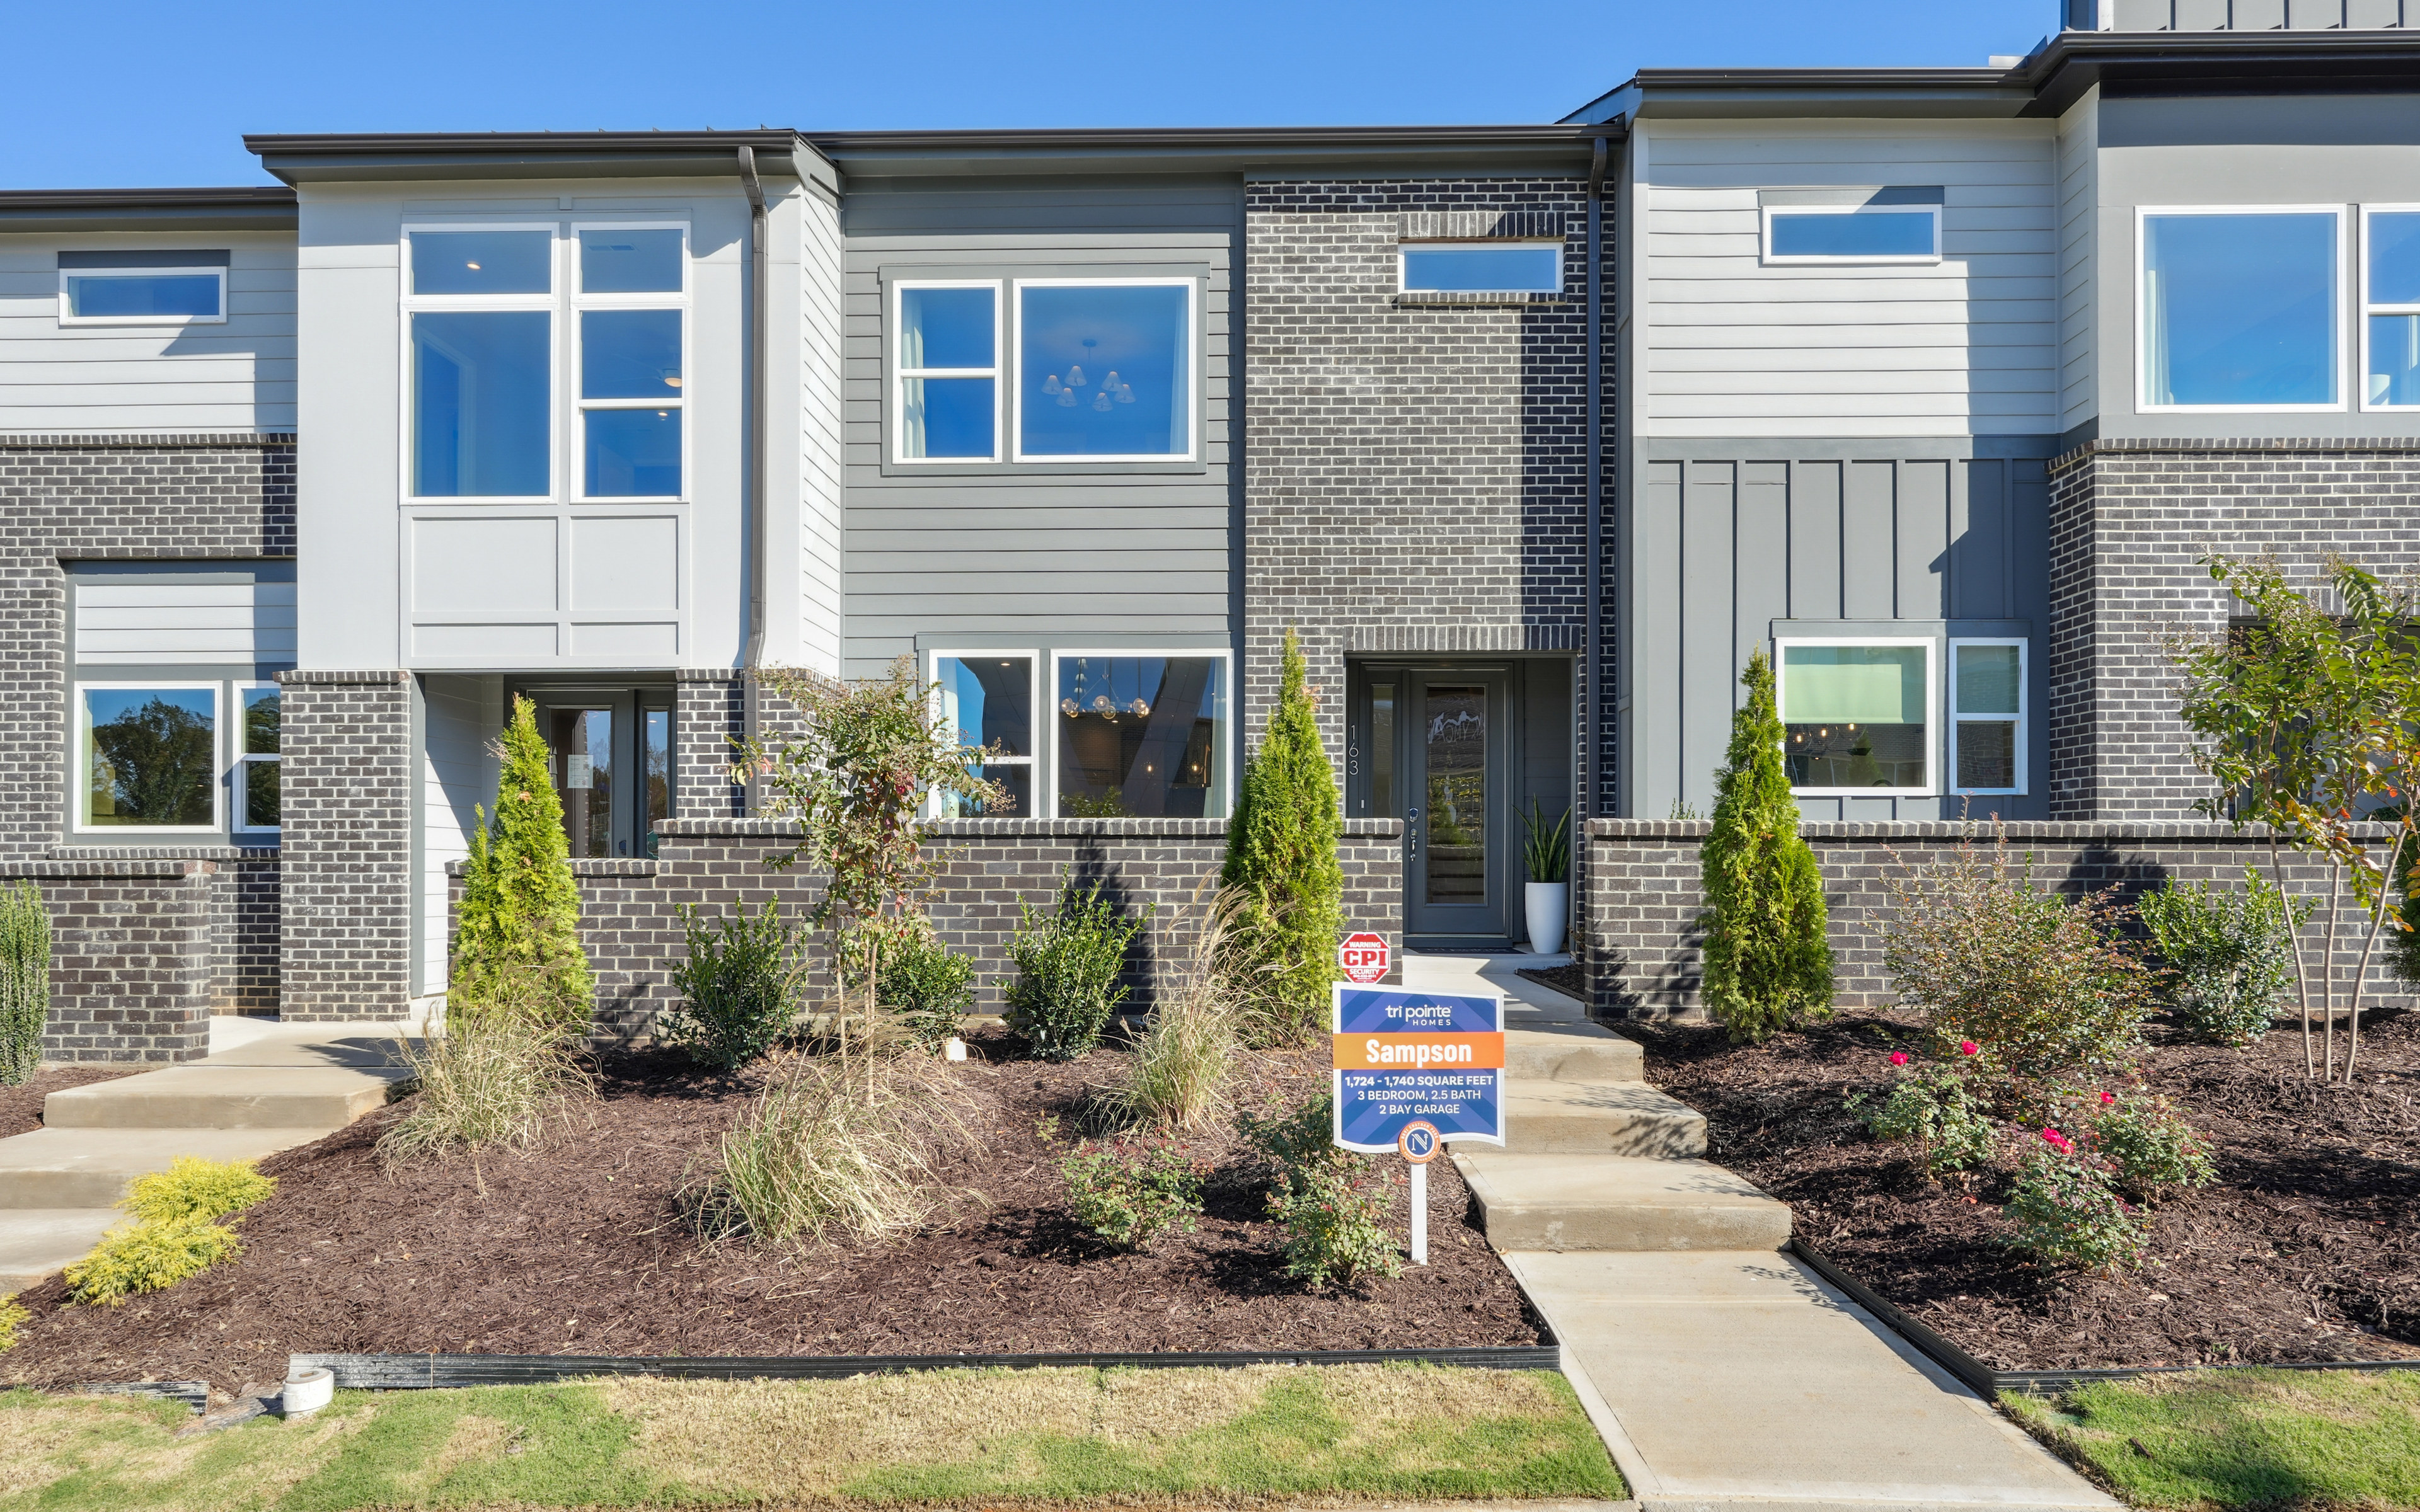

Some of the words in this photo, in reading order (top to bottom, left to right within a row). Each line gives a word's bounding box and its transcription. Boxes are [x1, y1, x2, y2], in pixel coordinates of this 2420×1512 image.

[1349, 724, 1359, 776] 163
[1344, 950, 1386, 966] CPI
[1385, 1005, 1403, 1018] tri
[1405, 1004, 1451, 1022] pointe
[1366, 1039, 1472, 1068] Sampson
[1345, 1076, 1374, 1088] 1,724
[1384, 1076, 1415, 1087] 1,740
[1417, 1075, 1464, 1087] SQUARE
[1466, 1075, 1494, 1085] FEET
[1357, 1091, 1365, 1101] 3
[1368, 1090, 1429, 1101] BEDROOM,
[1431, 1090, 1448, 1100] 2.5
[1451, 1089, 1481, 1099] BATH
[1379, 1104, 1386, 1114] 2
[1389, 1104, 1412, 1114] BAY
[1414, 1104, 1460, 1114] GARAGE
[1411, 1133, 1429, 1151] N
